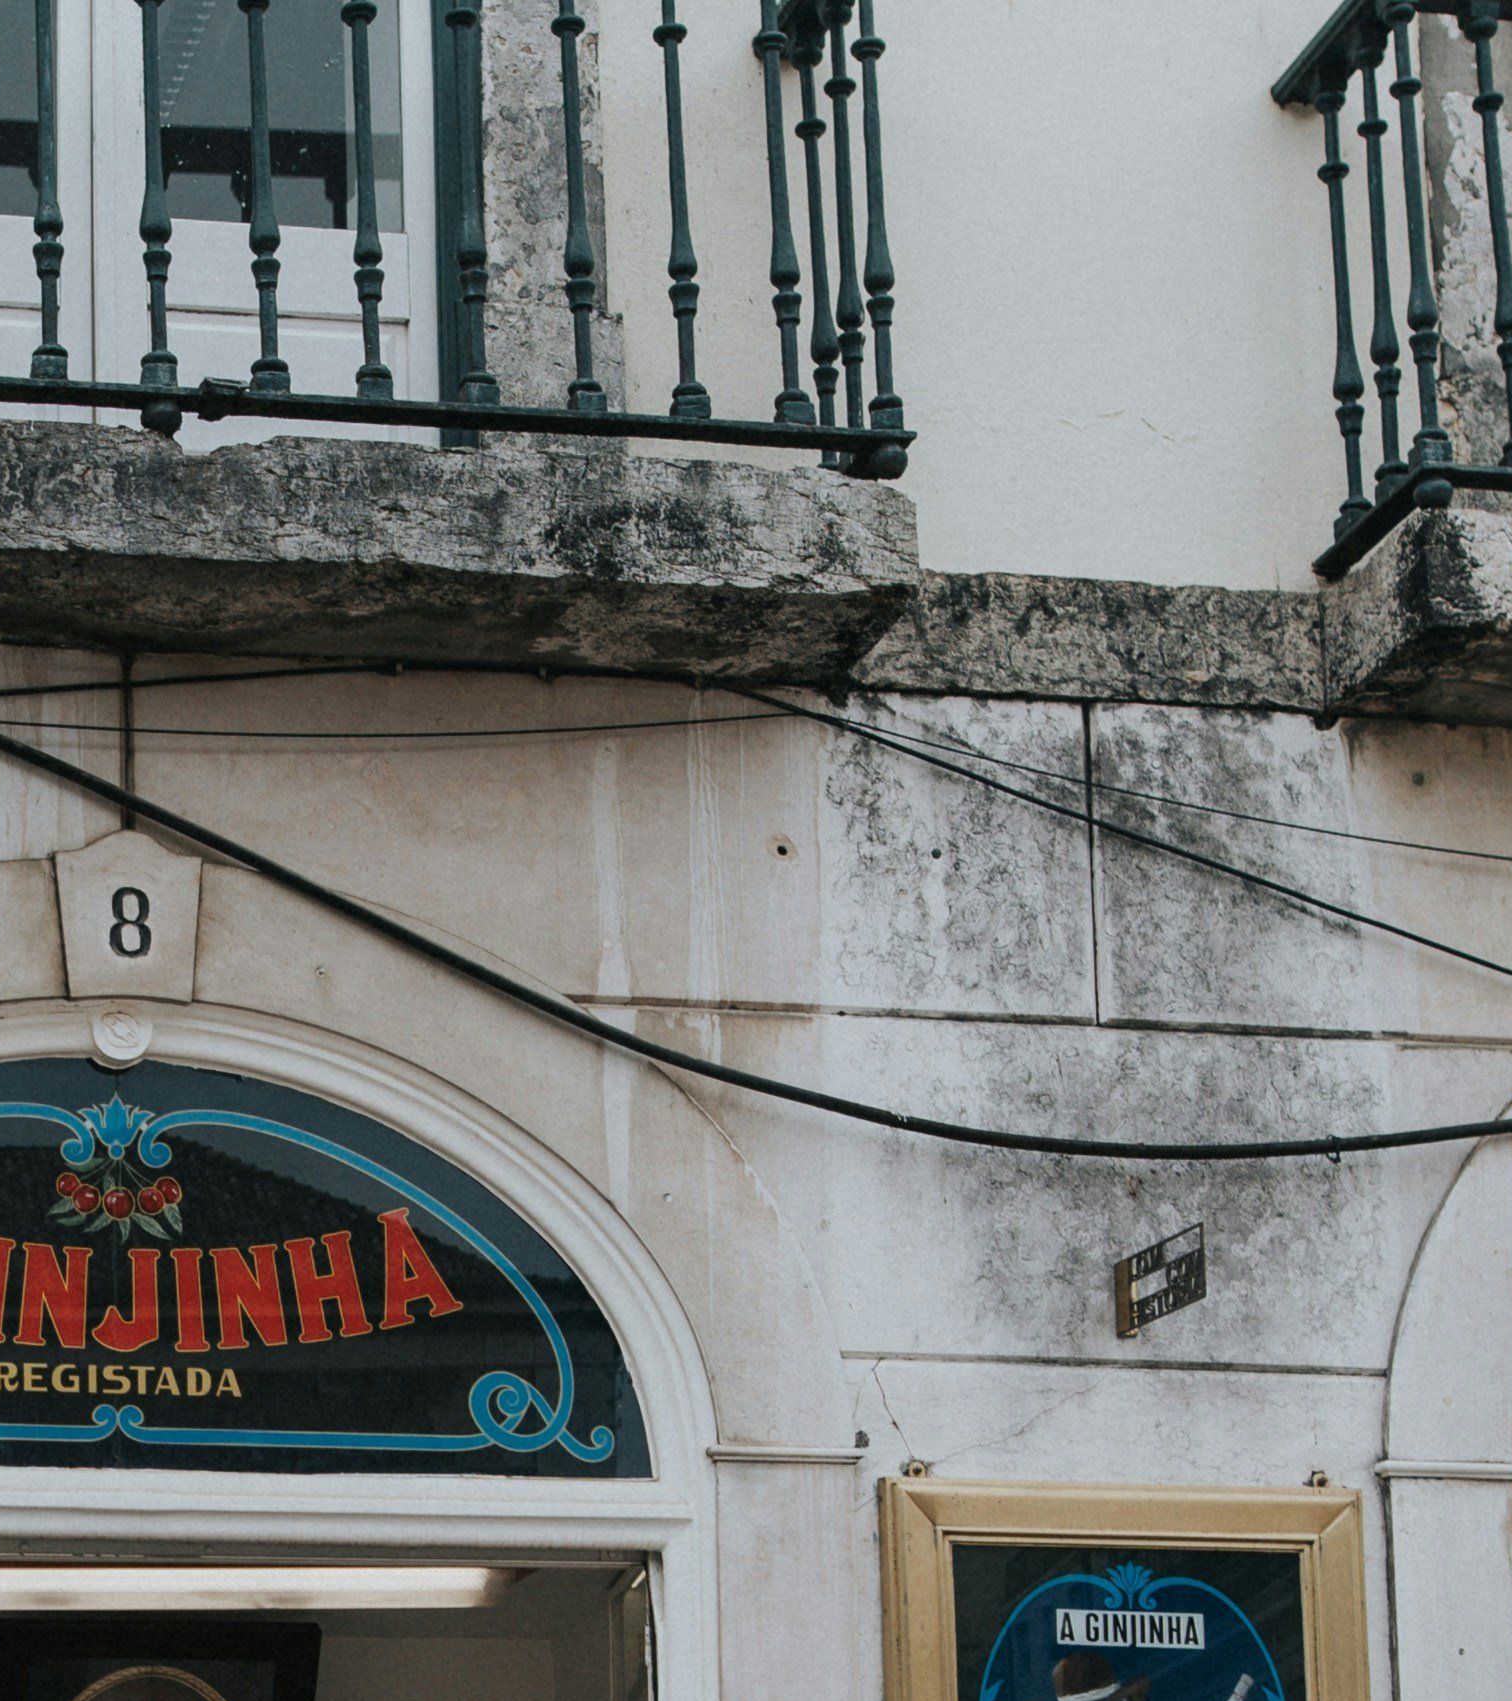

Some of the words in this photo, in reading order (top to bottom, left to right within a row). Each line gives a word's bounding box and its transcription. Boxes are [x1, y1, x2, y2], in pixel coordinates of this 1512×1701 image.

[108, 886, 153, 958] 8
[1059, 1612, 1076, 1642] A
[1084, 1613, 1201, 1648] GINJINHA
